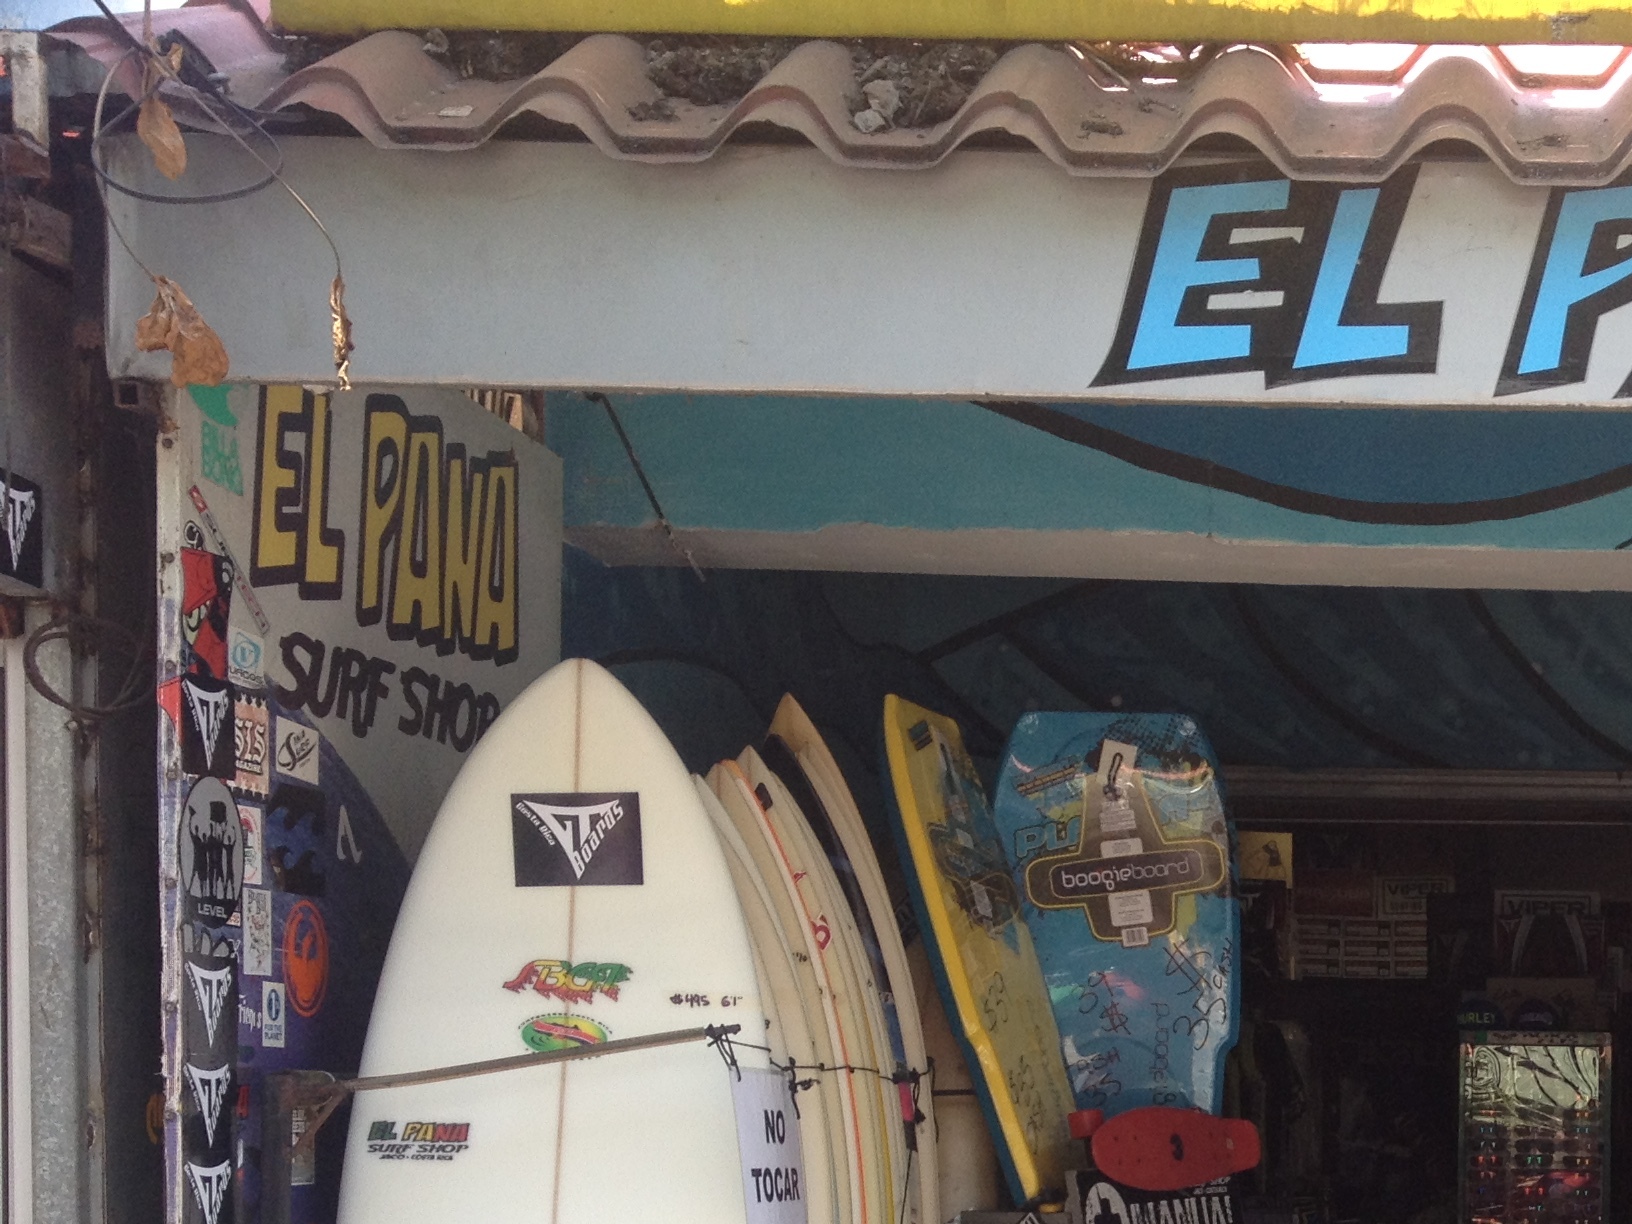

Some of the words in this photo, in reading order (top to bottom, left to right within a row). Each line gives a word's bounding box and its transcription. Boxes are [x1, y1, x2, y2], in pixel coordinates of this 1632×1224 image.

[1100, 174, 1430, 383] EL
[252, 384, 344, 598] EL
[357, 394, 518, 665] PANA
[279, 632, 395, 738] SURF
[397, 667, 500, 752] SHOP
[515, 802, 540, 829] Costa
[538, 824, 556, 846] Rica
[571, 802, 624, 878] Boards
[198, 902, 229, 919] LEVEL
[669, 993, 710, 1008] $495
[401, 1121, 470, 1142] PANA
[764, 1109, 786, 1145] NO
[367, 1143, 414, 1155] SURF
[416, 1143, 470, 1154] SHOP
[751, 1166, 800, 1204] TOCAR
